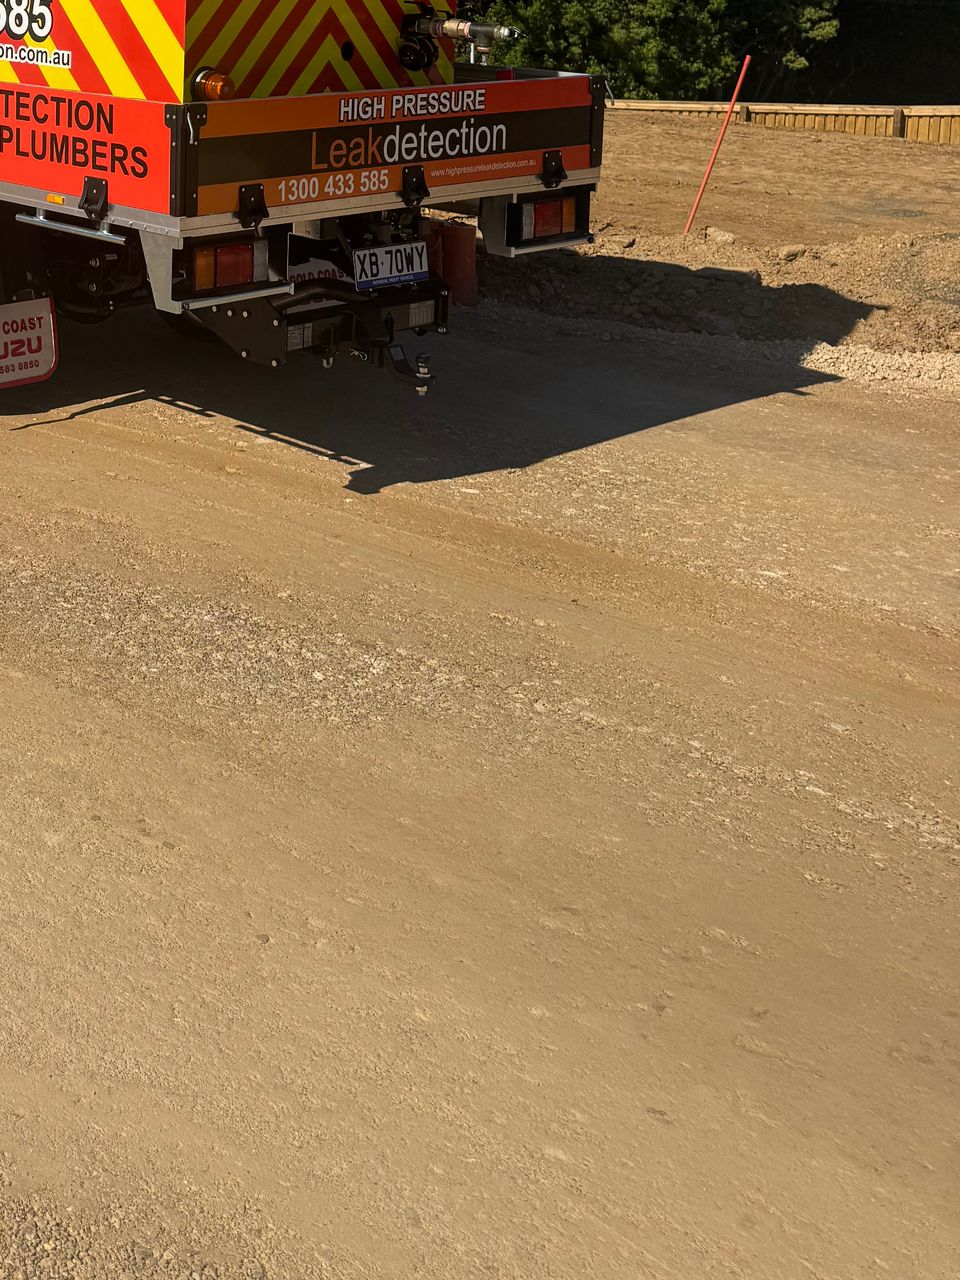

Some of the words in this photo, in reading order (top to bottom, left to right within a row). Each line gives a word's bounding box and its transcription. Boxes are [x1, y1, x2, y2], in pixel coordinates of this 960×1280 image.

[339, 96, 386, 122] HIGH
[391, 88, 487, 118] PRESSURE
[311, 118, 507, 171] Leakdetection
[278, 176, 319, 201] 1300
[324, 172, 355, 197] 433
[360, 169, 390, 194] 585
[1, 316, 44, 335] COAST
